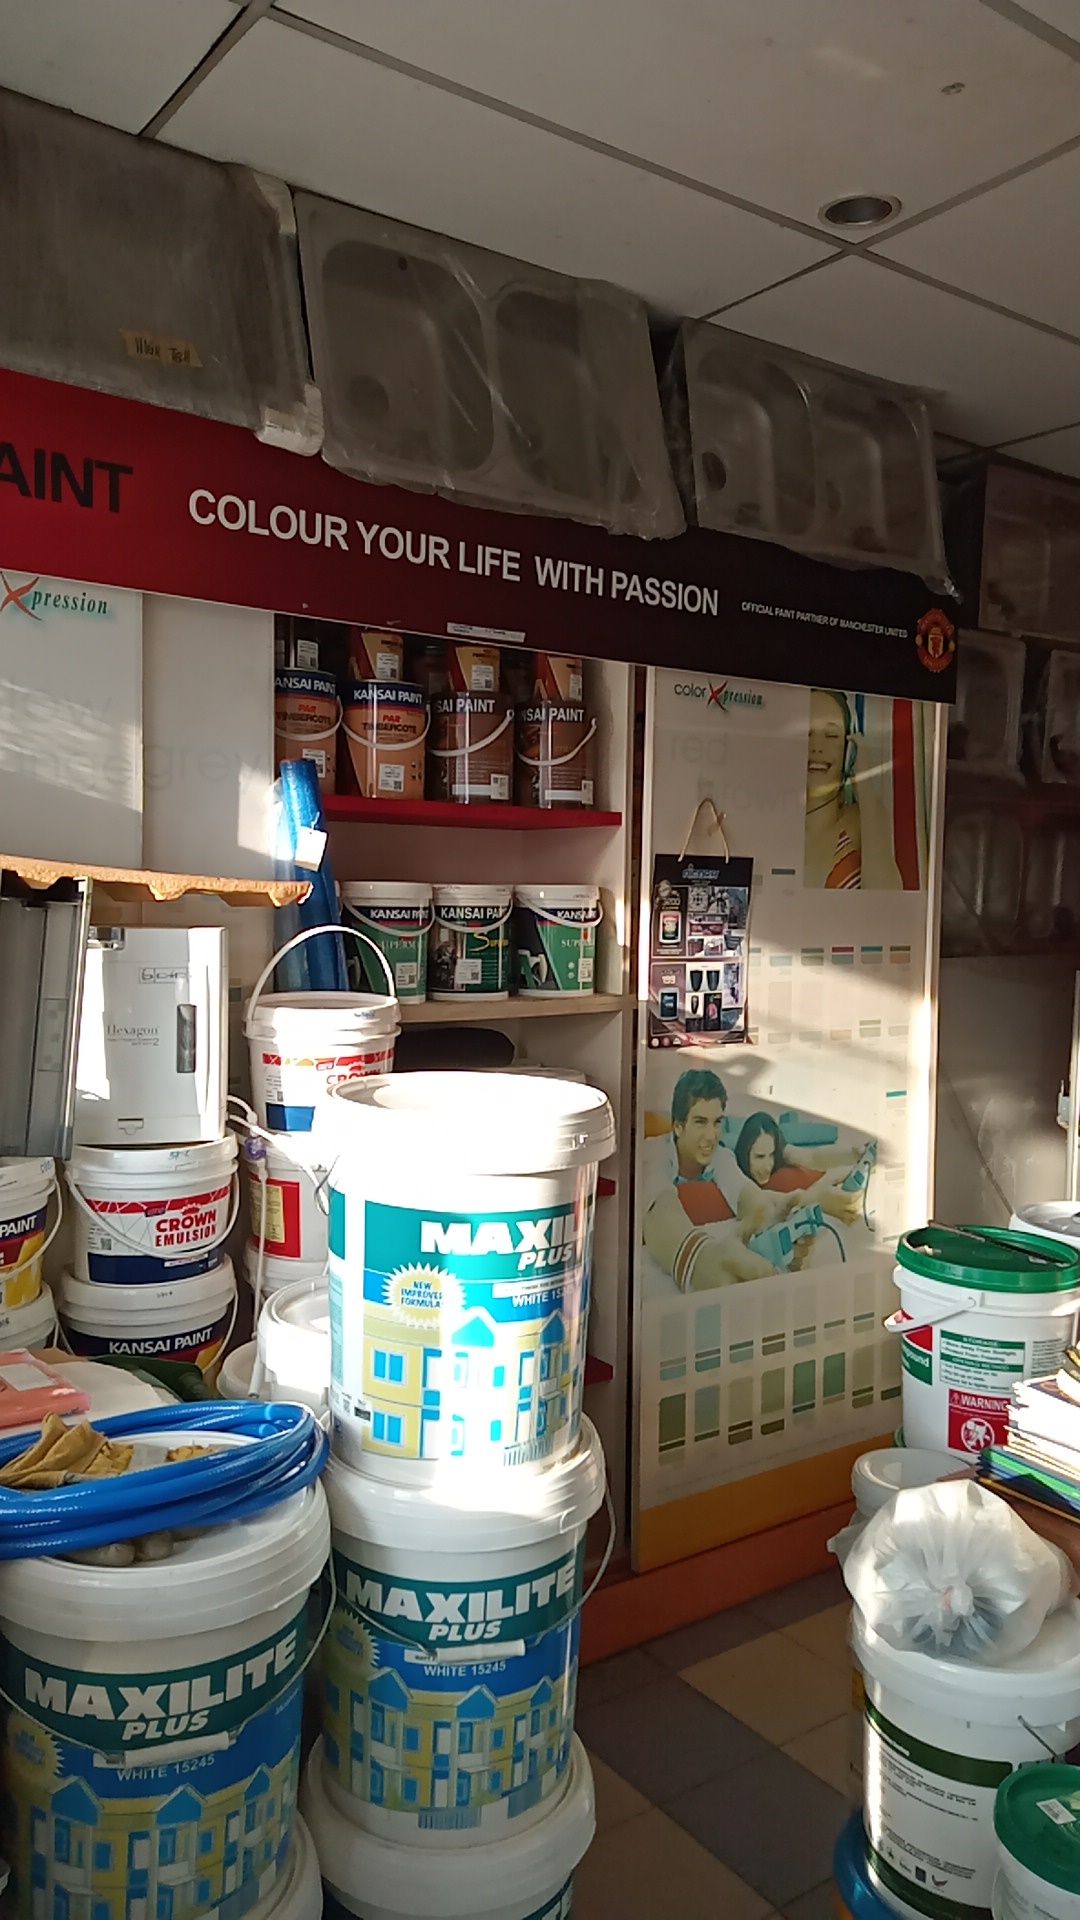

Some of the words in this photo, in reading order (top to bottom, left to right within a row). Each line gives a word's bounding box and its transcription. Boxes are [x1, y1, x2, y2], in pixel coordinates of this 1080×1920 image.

[189, 489, 349, 551] COLOUR
[356, 519, 451, 569] YOUR
[459, 541, 521, 582] LIFE
[534, 555, 604, 597] WITH
[611, 570, 719, 616] PASSION
[741, 601, 774, 616] OFFICIAL
[775, 607, 796, 620] PAINT
[796, 611, 829, 626] PARTNER
[829, 616, 839, 627] OF
[839, 619, 884, 635] MANCHESTER
[884, 628, 908, 639] UNITED
[353, 688, 396, 701] KANSAI
[398, 691, 423, 705] PAINT
[456, 699, 496, 713] PAINT
[383, 714, 402, 723] PAR
[550, 708, 584, 722] PAINT
[370, 908, 411, 919] KANSAI
[440, 906, 484, 920] KANSAI
[0, 1214, 38, 1237] PAINT
[155, 1209, 217, 1233] CROWN
[155, 1223, 217, 1248] EMULSION
[517, 1243, 574, 1271] PLUS
[413, 1280, 433, 1291] NEW
[512, 1293, 548, 1308] WHITE
[108, 1339, 170, 1355] KANSAI
[174, 1327, 213, 1350] PAINT
[960, 1393, 1009, 1411] WARNING
[346, 1557, 576, 1624] MAXILITE
[428, 1620, 502, 1642] PLUS
[24, 1628, 298, 1722] MAXILITE
[424, 1664, 466, 1678] WHITE
[471, 1661, 506, 1676] 15245
[121, 1709, 210, 1742] PLUS
[116, 1767, 167, 1782] WHITE
[173, 1753, 216, 1776] 15245
